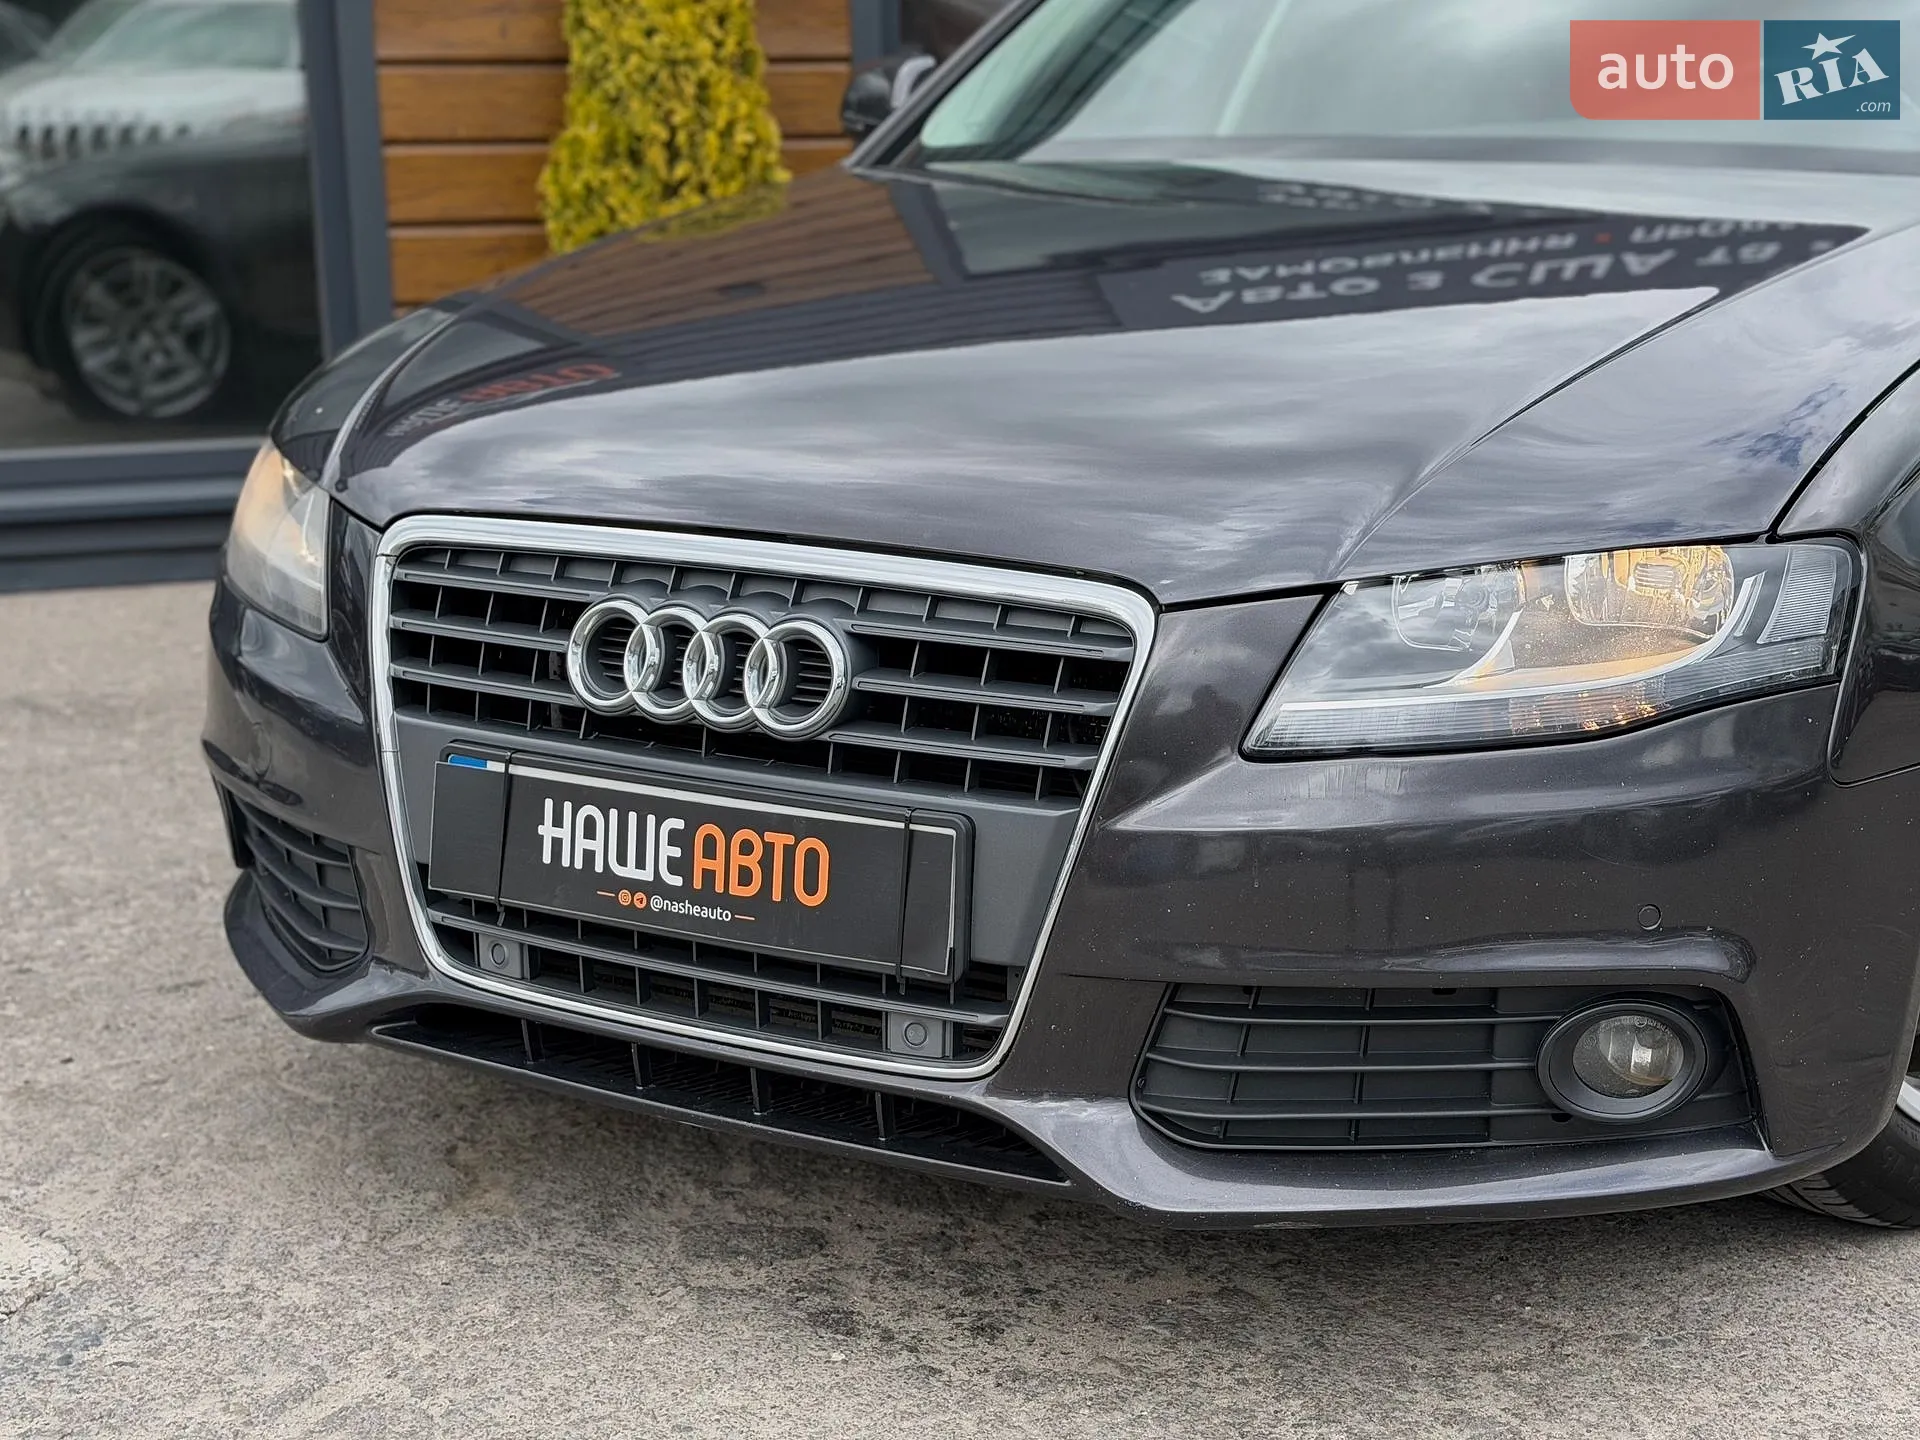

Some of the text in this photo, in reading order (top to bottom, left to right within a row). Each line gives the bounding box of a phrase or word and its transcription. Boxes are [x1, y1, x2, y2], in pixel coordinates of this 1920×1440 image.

[538, 798, 831, 907] НАШЕ АВТО
[649, 894, 732, 922] @nasheauto
